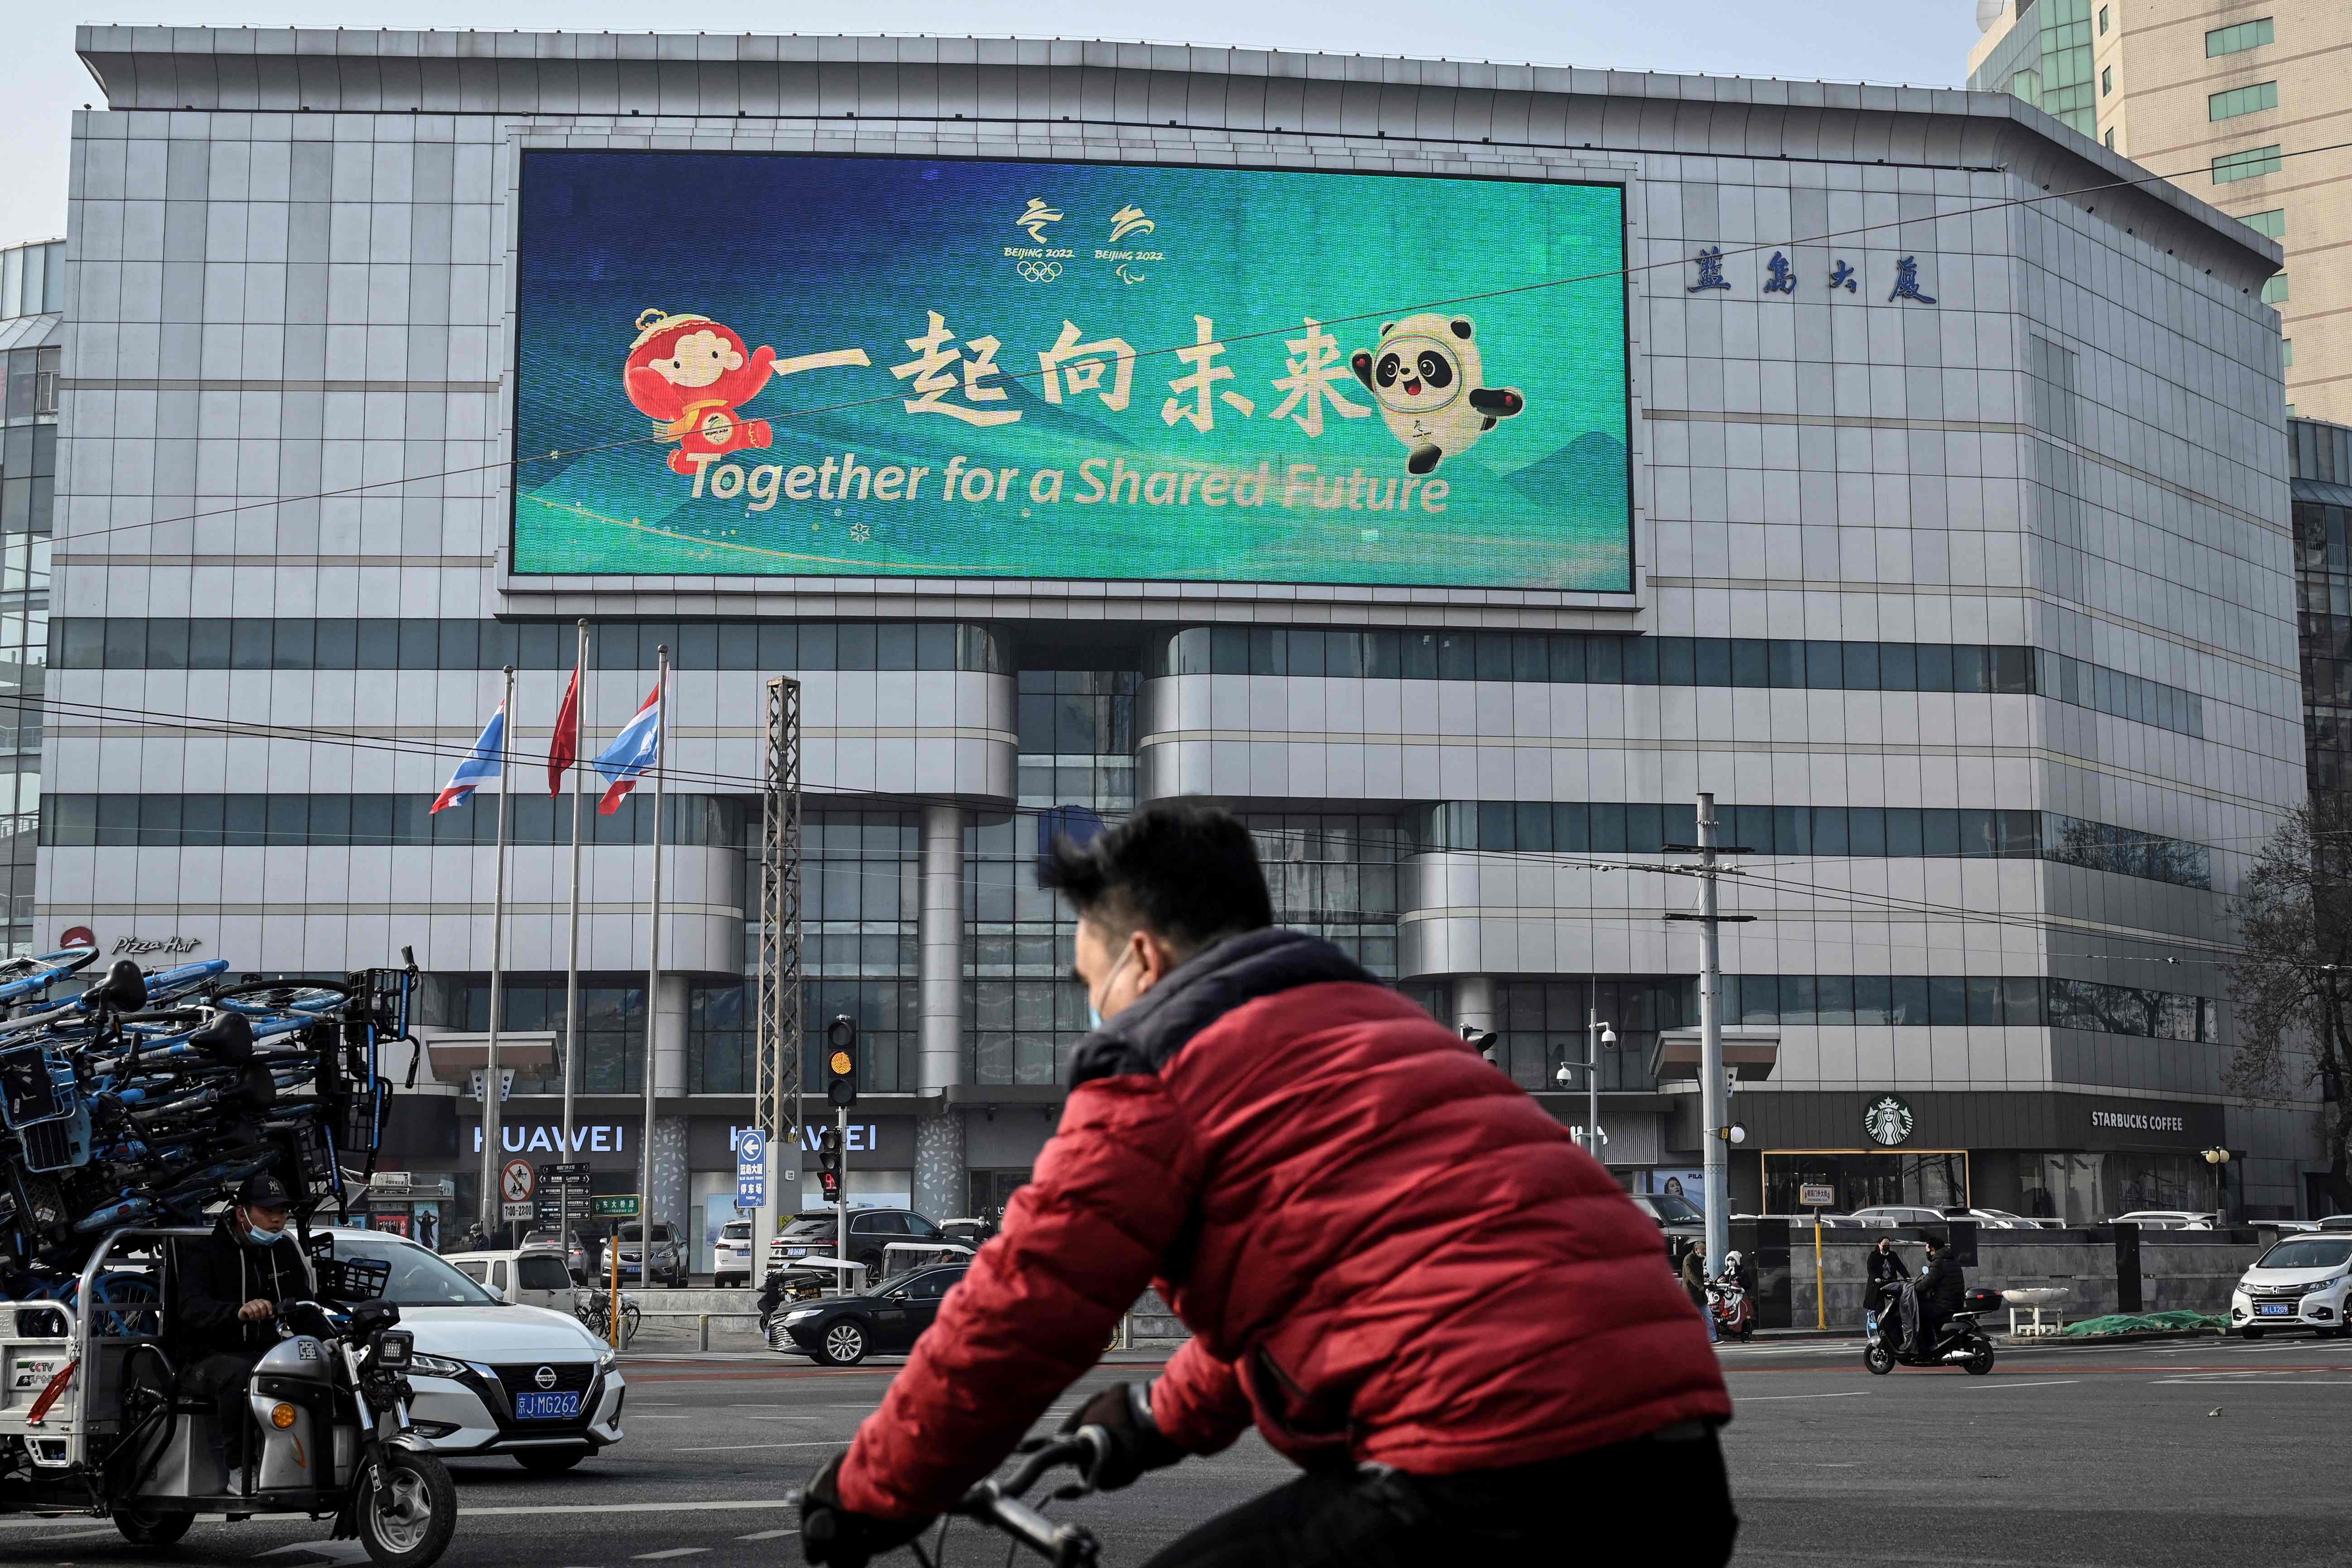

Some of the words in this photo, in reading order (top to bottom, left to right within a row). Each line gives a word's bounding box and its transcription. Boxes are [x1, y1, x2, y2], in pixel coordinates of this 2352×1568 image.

[1004, 247, 1042, 258] BEIJING
[1045, 249, 1075, 258] 2022
[1094, 250, 1132, 261] BEIJING
[1135, 251, 1164, 261] 2022
[769, 308, 1372, 438] 一起向未来
[686, 453, 930, 511] Together
[942, 455, 1020, 502] for
[1029, 469, 1064, 504] a
[1074, 458, 1269, 507] Shared
[1282, 464, 1449, 513] Future
[111, 936, 160, 955] Pizza
[163, 936, 201, 953] Hut
[2092, 1111, 2148, 1129] STARBUCKS
[2149, 1116, 2182, 1131] COFFEE
[740, 1183, 762, 1195] 停车场
[603, 1200, 634, 1209] 东大桥路
[505, 1206, 531, 1217] 7:00-22:00
[298, 1341, 318, 1360] 强
[29, 1362, 54, 1372] CCTV
